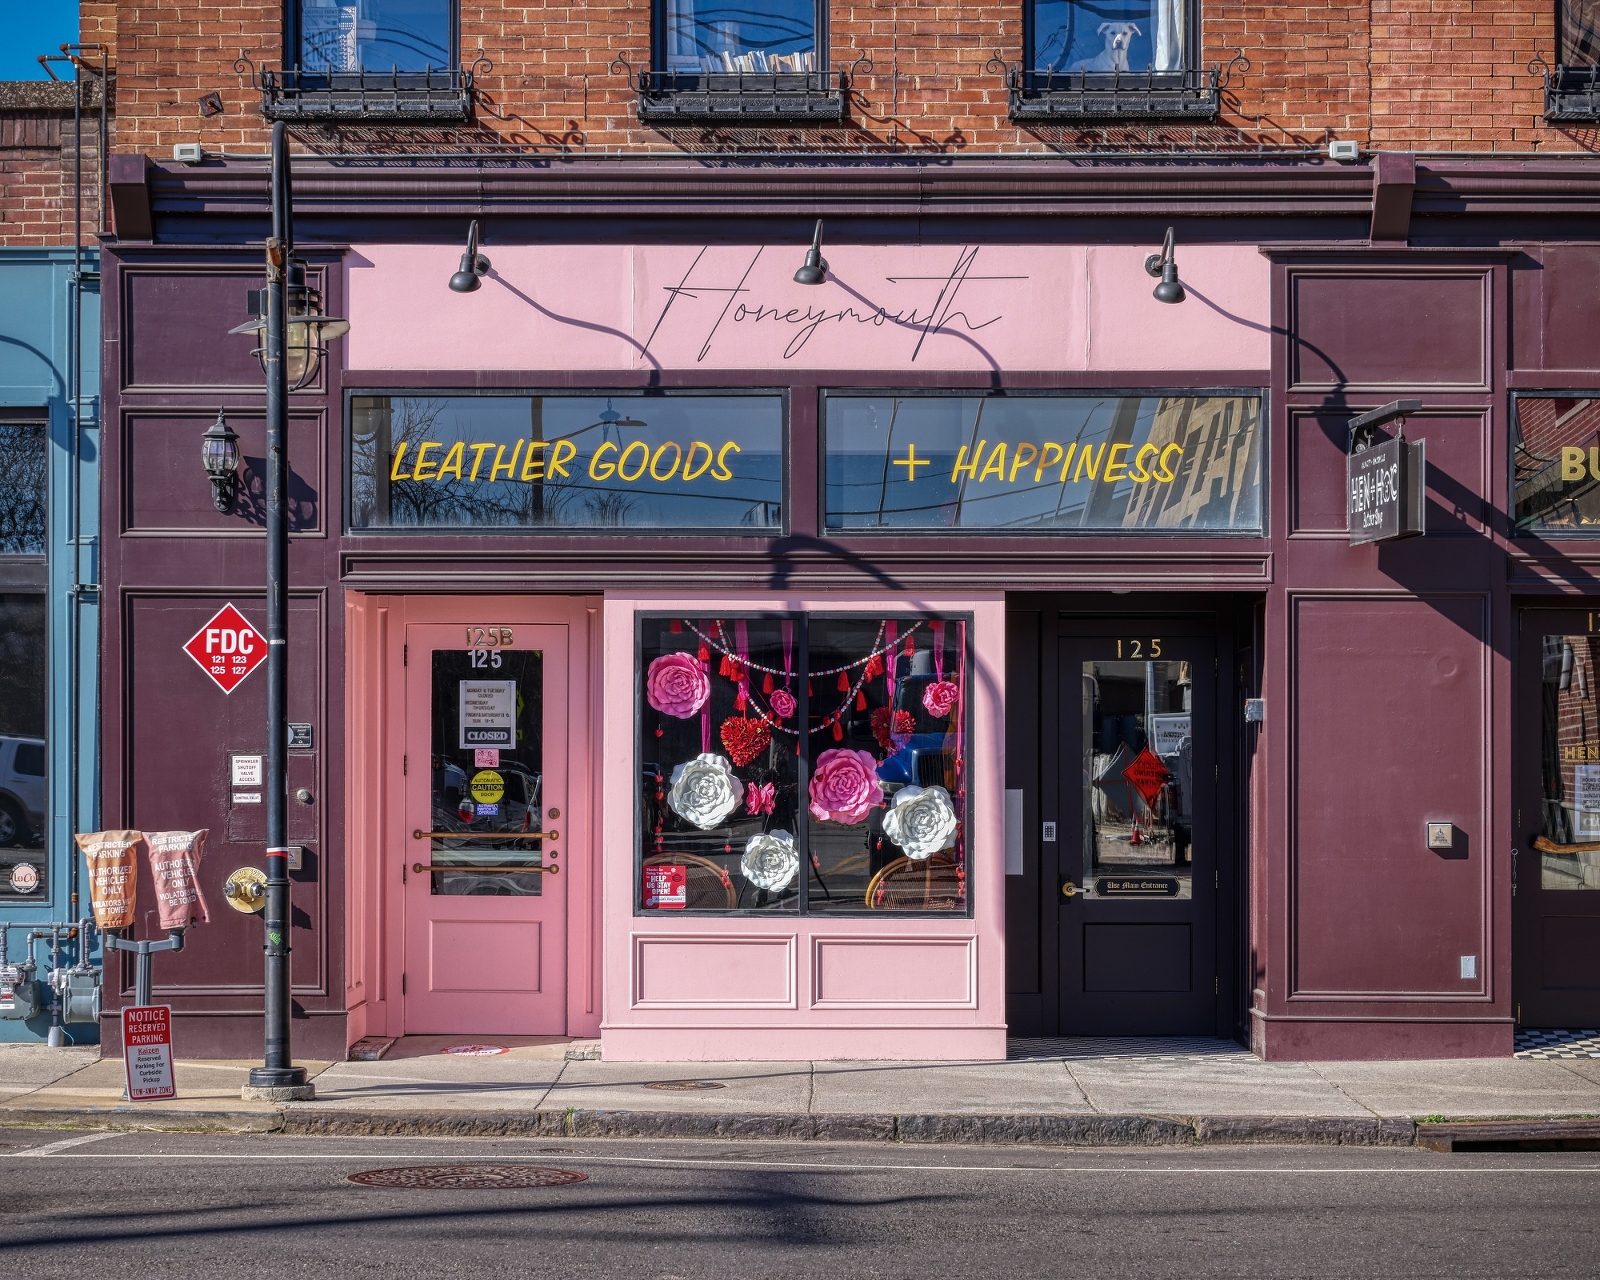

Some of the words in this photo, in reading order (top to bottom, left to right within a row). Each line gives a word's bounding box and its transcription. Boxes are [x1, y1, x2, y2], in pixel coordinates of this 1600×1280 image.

[305, 32, 338, 45] BLACK
[305, 48, 338, 62] LIVES
[641, 245, 1029, 361] Honeymouth
[390, 438, 577, 482] LEATHER
[588, 440, 741, 482] GOODS
[893, 443, 930, 481] +
[951, 439, 1184, 483] HAPPINESS
[205, 628, 254, 654] FDC
[466, 627, 514, 647] 125B
[1116, 638, 1162, 659] 125
[211, 655, 225, 664] 121
[231, 655, 247, 664] 123
[467, 650, 503, 669] 125
[210, 666, 226, 674] 125
[231, 666, 246, 674] 127
[467, 731, 508, 740] CLOSED
[1564, 747, 1599, 759] HEN
[87, 841, 132, 853] RESTRICTED
[158, 842, 192, 853] PARKING
[92, 849, 126, 860] PARKING
[154, 858, 195, 872] AUTHORIZ
[88, 865, 133, 878] AUTHORIZED
[161, 868, 196, 880] VEHICLES
[95, 875, 128, 887] VEHICLES
[171, 878, 190, 888] ONLY
[102, 886, 122, 895] ONLY
[159, 889, 191, 901] VIOLATORS
[92, 899, 121, 909] VIOLATORS
[169, 898, 178, 907] BE
[179, 895, 197, 905] TOWED
[98, 907, 106, 915] BE
[107, 905, 128, 915] TOWED
[128, 1010, 165, 1022] NOTICE
[128, 1023, 166, 1033] RESERVED
[132, 1034, 163, 1044] PARKING
[138, 1047, 159, 1055] Kaizen
[133, 1087, 158, 1096] TOW-AWAY
[159, 1085, 172, 1094] ZONE
